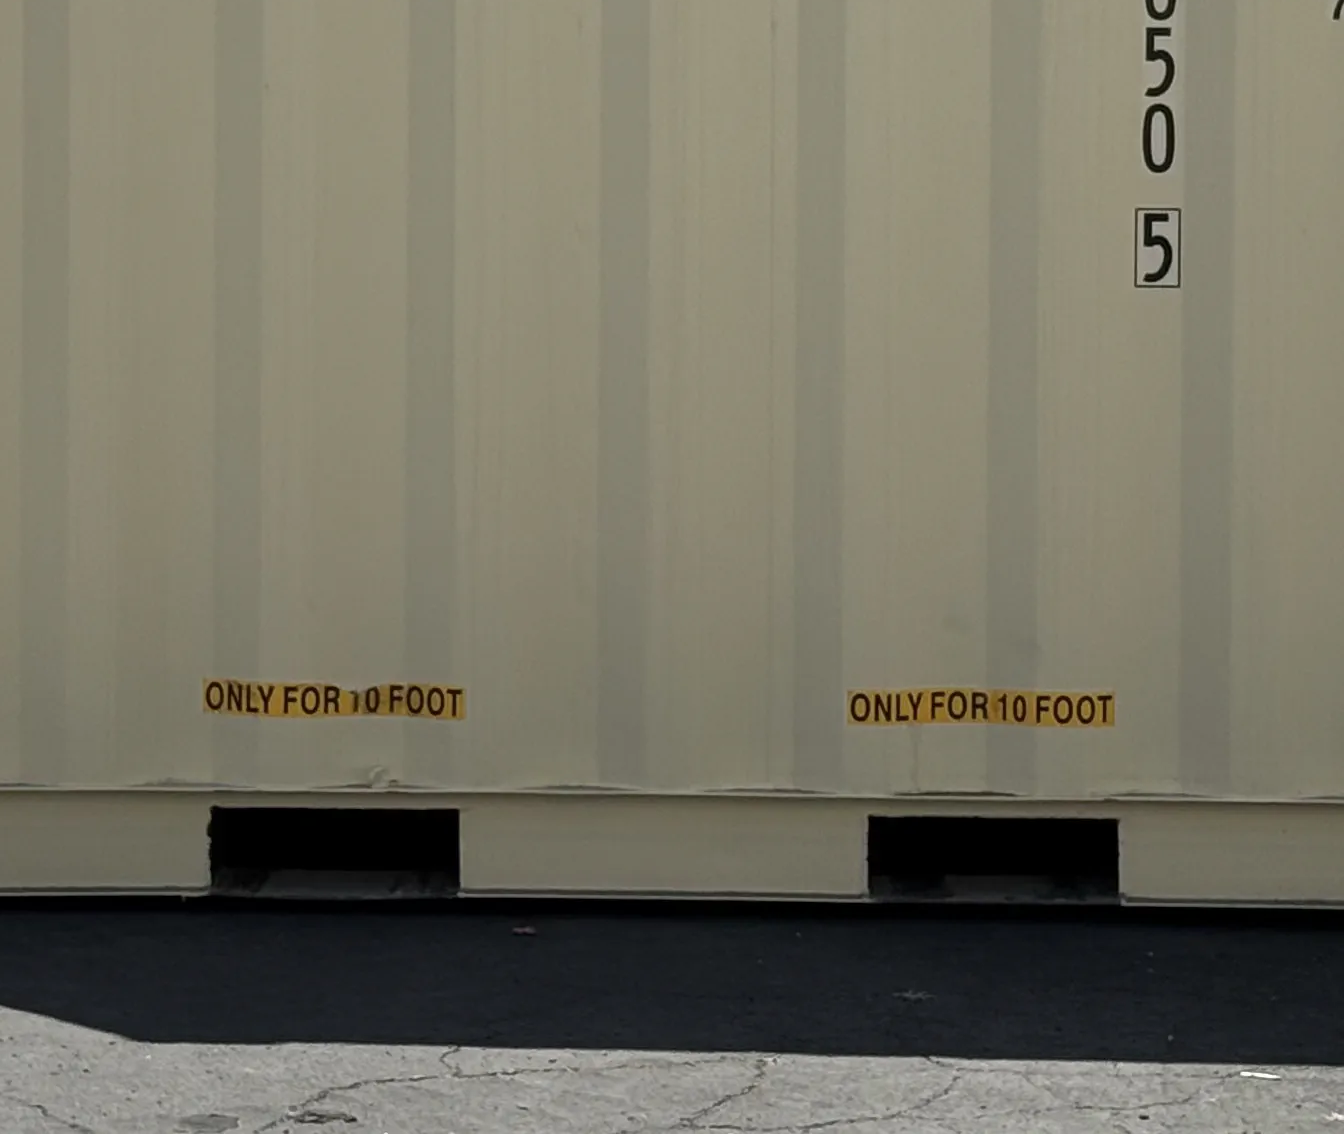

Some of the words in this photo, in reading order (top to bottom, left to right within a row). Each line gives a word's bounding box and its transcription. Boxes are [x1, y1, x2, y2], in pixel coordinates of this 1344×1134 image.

[1142, 212, 1174, 283] 5
[206, 680, 275, 714] ONLY
[283, 685, 341, 715] FOR
[350, 685, 381, 714] 10
[389, 684, 463, 717] FOOT
[850, 692, 924, 722] ONLY
[930, 691, 989, 721] FOR
[997, 694, 1027, 723] 10
[1035, 694, 1113, 725] FOOT
